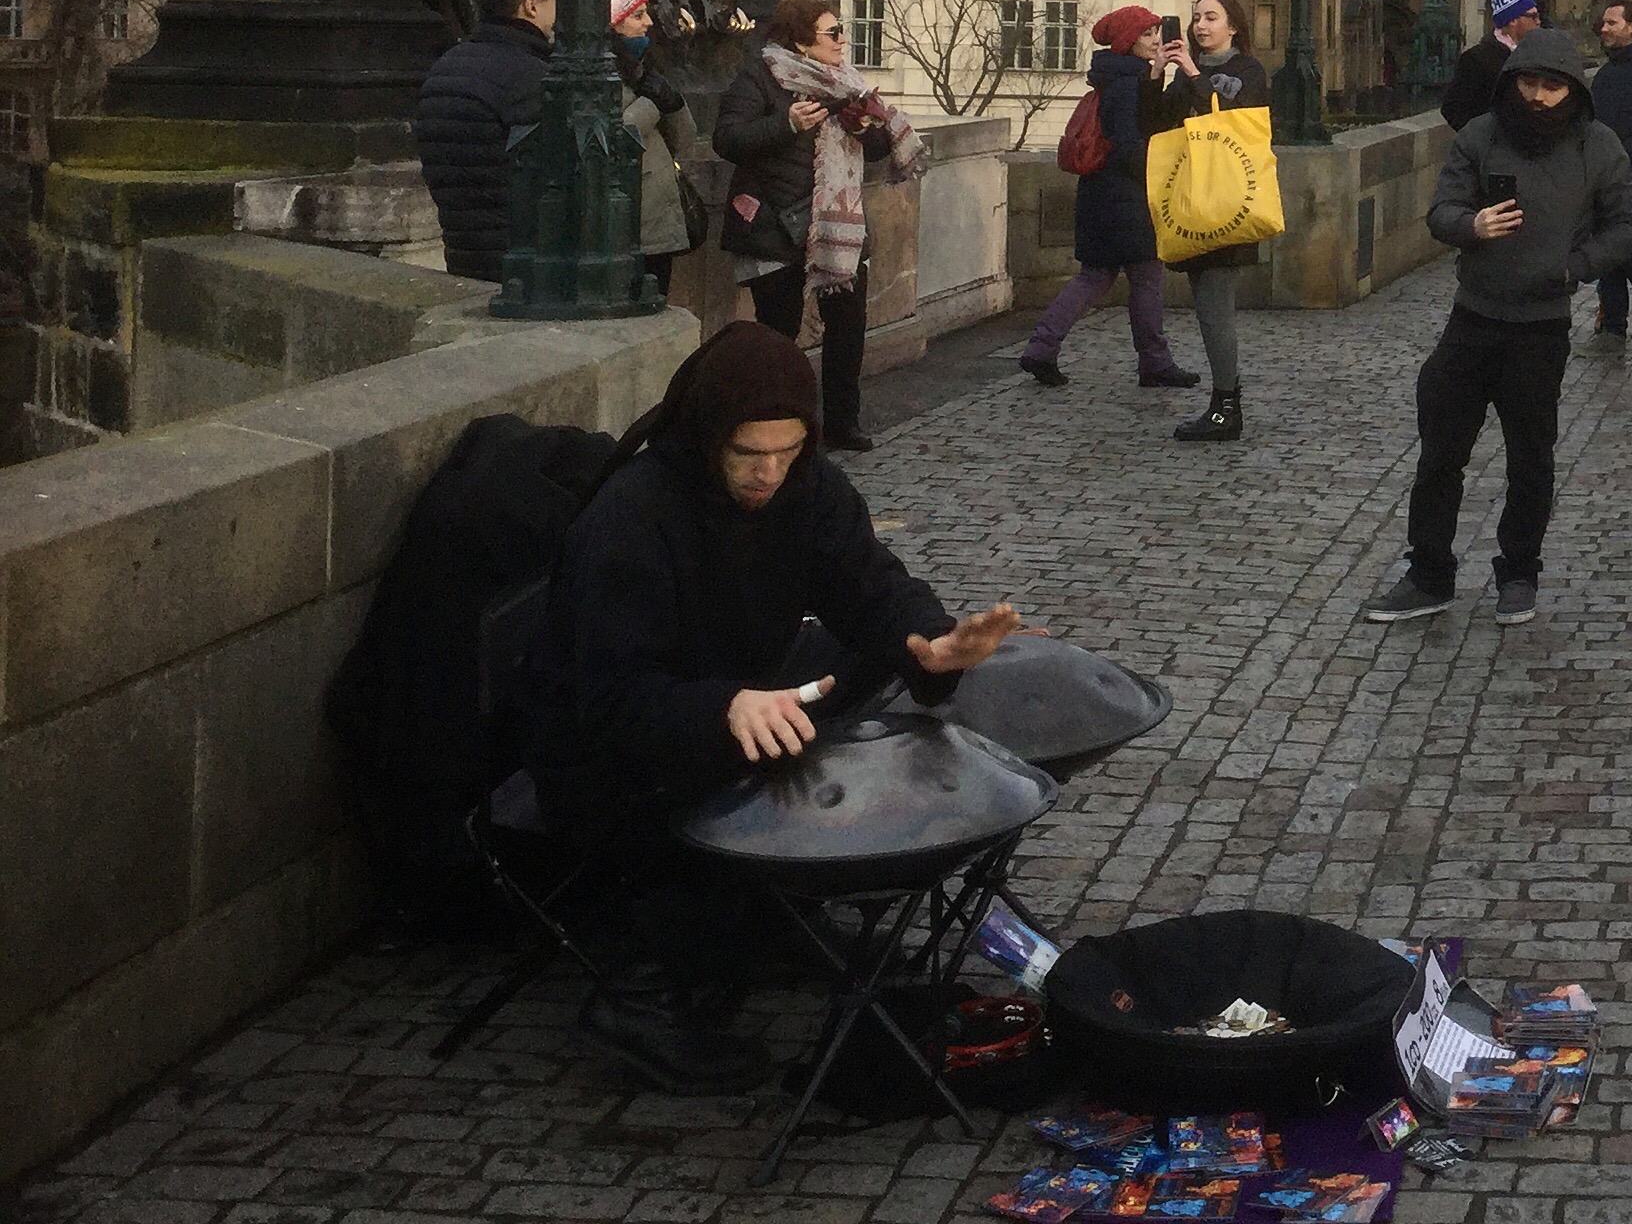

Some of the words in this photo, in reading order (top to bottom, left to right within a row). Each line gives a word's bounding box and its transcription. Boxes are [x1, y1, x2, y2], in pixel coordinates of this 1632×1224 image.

[1206, 130, 1220, 142] OR
[1222, 136, 1255, 177] RECYCLE
[1165, 151, 1187, 189] PLEASE
[1247, 179, 1257, 191] AT
[1244, 194, 1254, 202] A
[1176, 204, 1250, 241] PARTICIPATING
